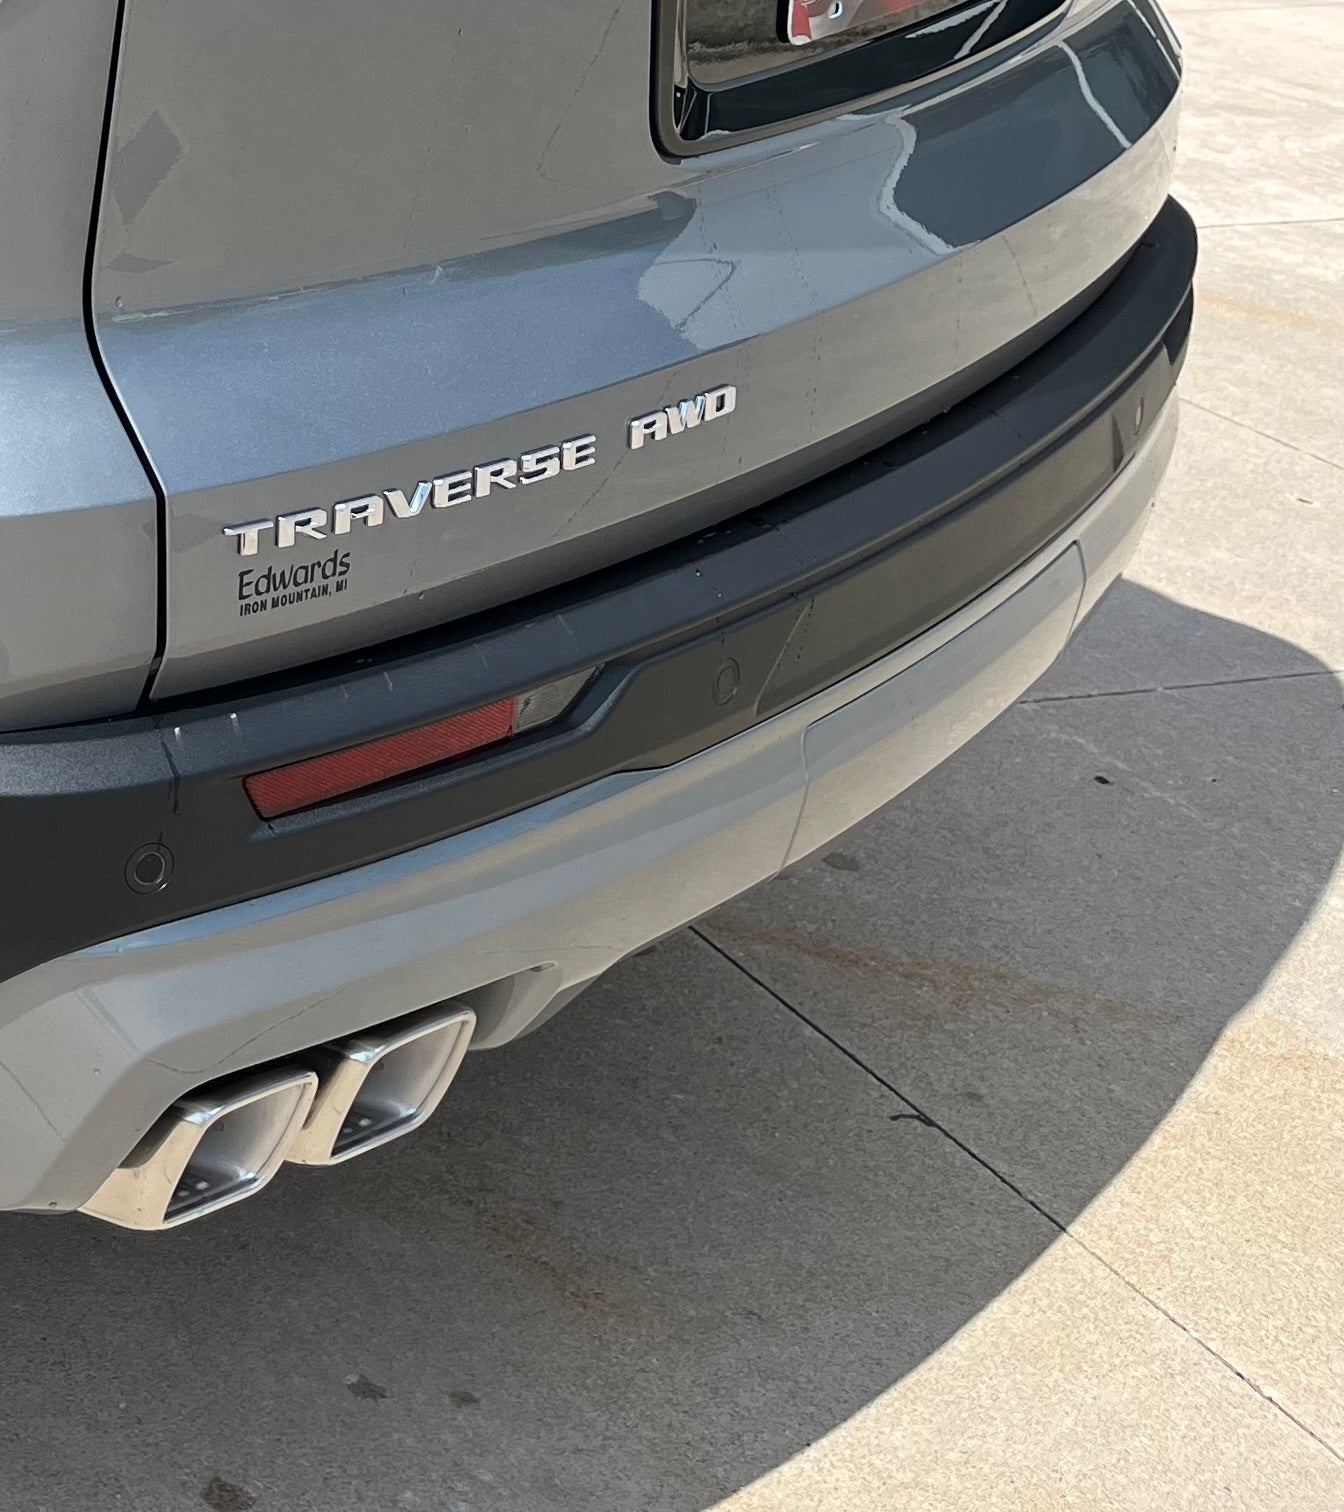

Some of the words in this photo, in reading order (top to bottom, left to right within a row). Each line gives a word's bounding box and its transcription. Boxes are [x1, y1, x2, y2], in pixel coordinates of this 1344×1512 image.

[223, 434, 596, 556] TRAVERSE
[627, 384, 736, 450] AWD
[238, 549, 351, 600] Edwards
[239, 599, 268, 617] IRON
[271, 583, 332, 610] MOUNTAIN,
[335, 578, 348, 593] MI
